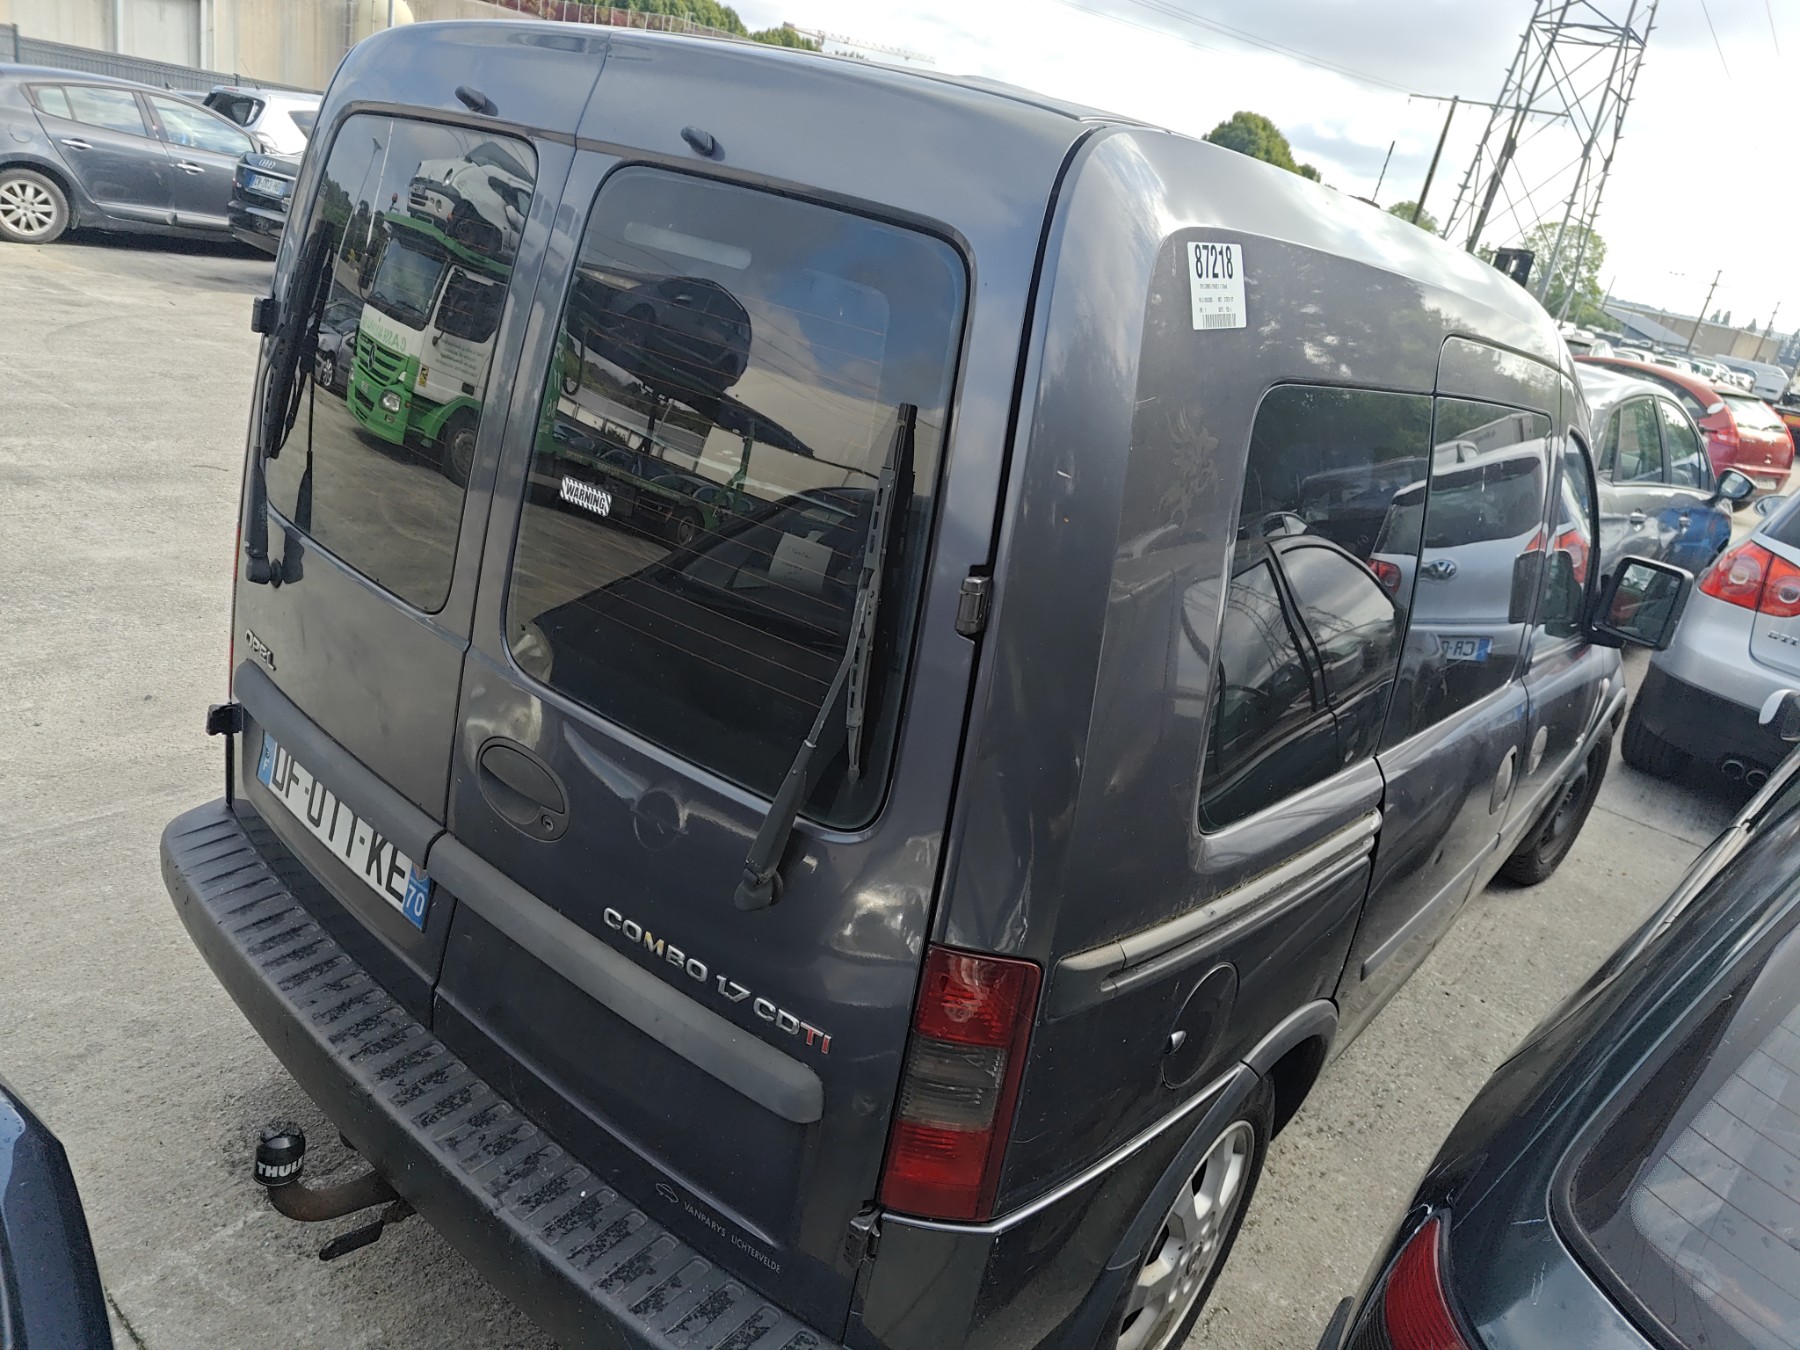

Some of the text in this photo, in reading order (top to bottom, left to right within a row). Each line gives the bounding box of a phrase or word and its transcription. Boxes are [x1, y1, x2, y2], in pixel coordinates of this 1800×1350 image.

[1194, 243, 1234, 280] 87218
[566, 482, 606, 510] WARNING
[245, 628, 276, 671] OPEL
[406, 884, 425, 917] 70
[603, 907, 708, 983] COMBO
[753, 997, 833, 1056] CDTI
[257, 1155, 303, 1177] THUL
[684, 1202, 781, 1274] VANPARYS LICHTERVELDE
